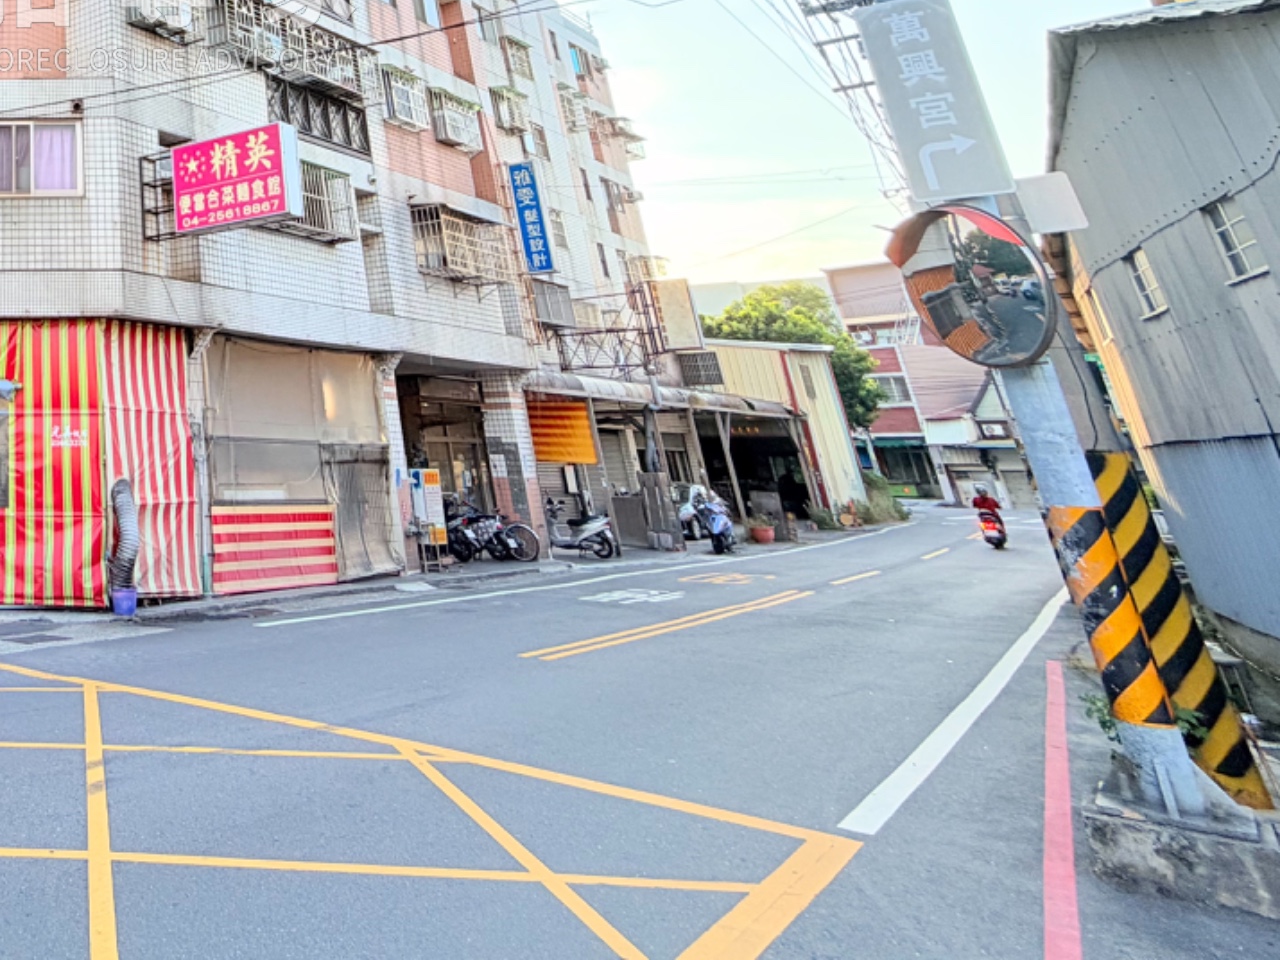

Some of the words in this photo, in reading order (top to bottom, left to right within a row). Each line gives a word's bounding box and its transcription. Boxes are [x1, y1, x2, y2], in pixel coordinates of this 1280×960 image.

[882, 10, 958, 130] 萬興宮
[209, 130, 275, 181] 精英
